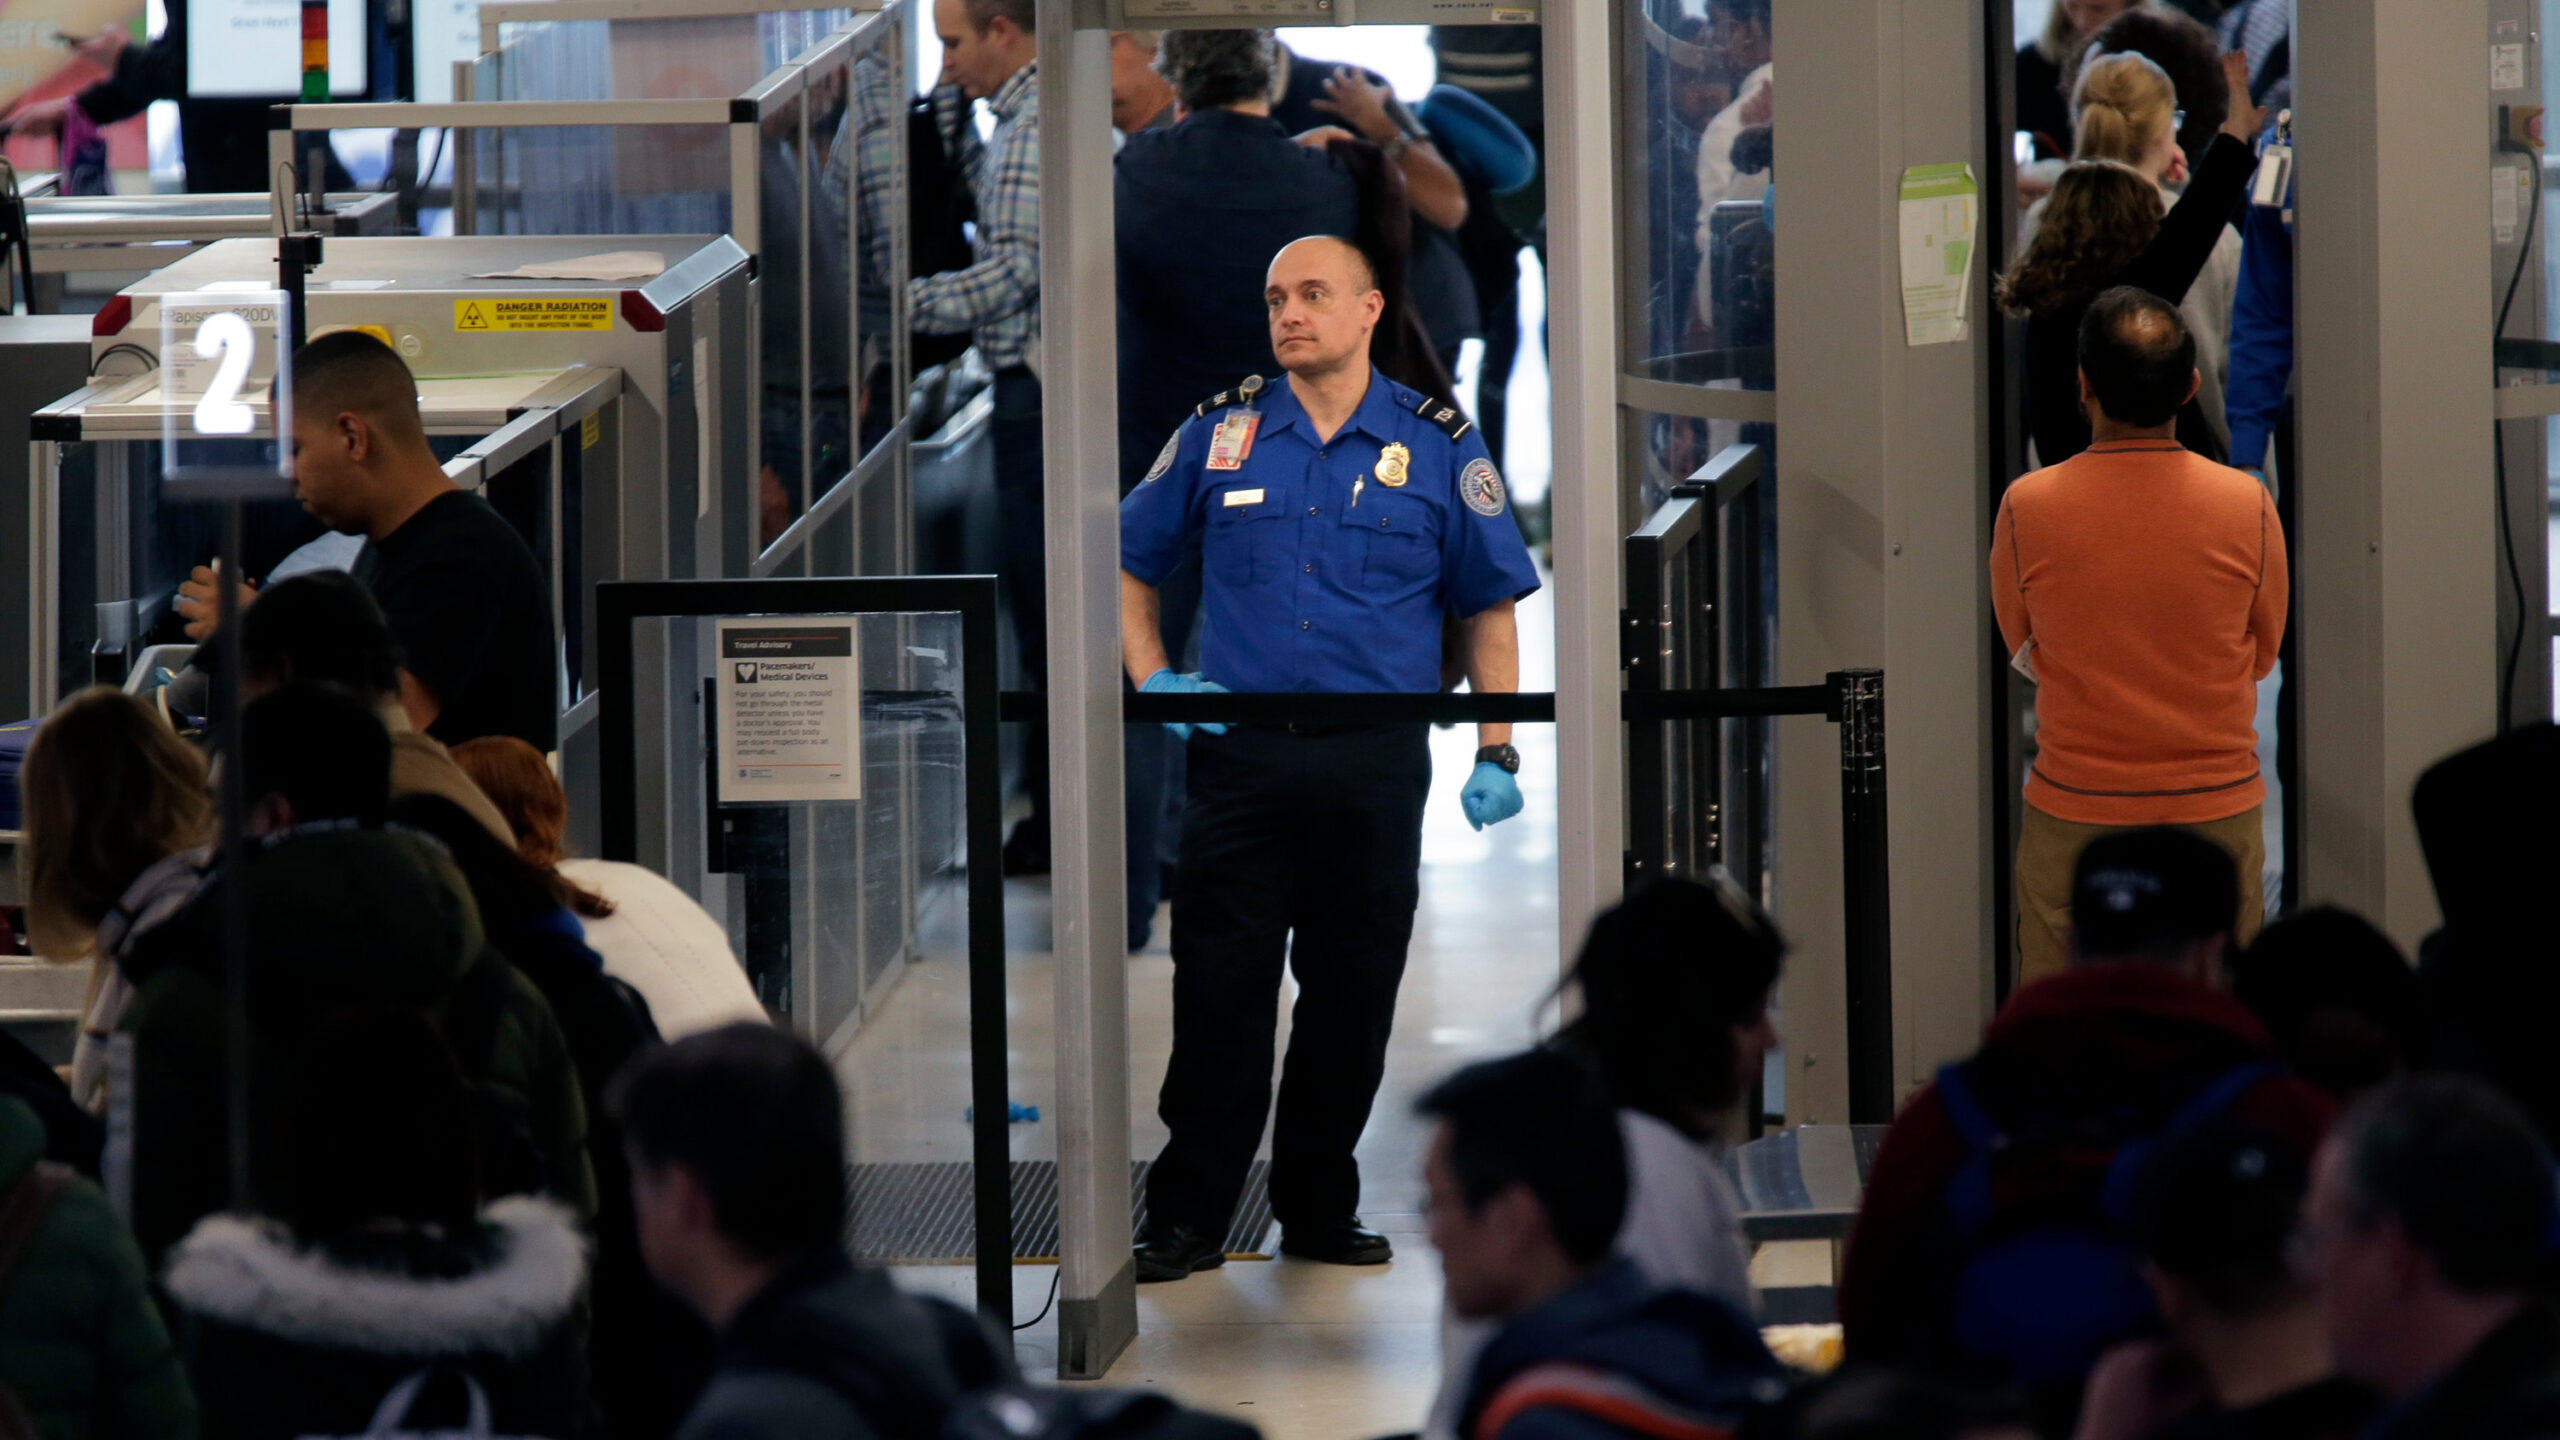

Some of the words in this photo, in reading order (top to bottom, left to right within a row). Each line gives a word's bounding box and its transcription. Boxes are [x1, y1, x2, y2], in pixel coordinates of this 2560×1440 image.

[497, 303, 542, 311] DANGER
[547, 303, 607, 311] RADIATION
[193, 311, 256, 434] 2
[735, 641, 758, 649] Travel
[759, 641, 792, 650] Advisory
[760, 662, 815, 670] Pacemakers/
[760, 673, 793, 681] Medical
[795, 672, 829, 680] Devices
